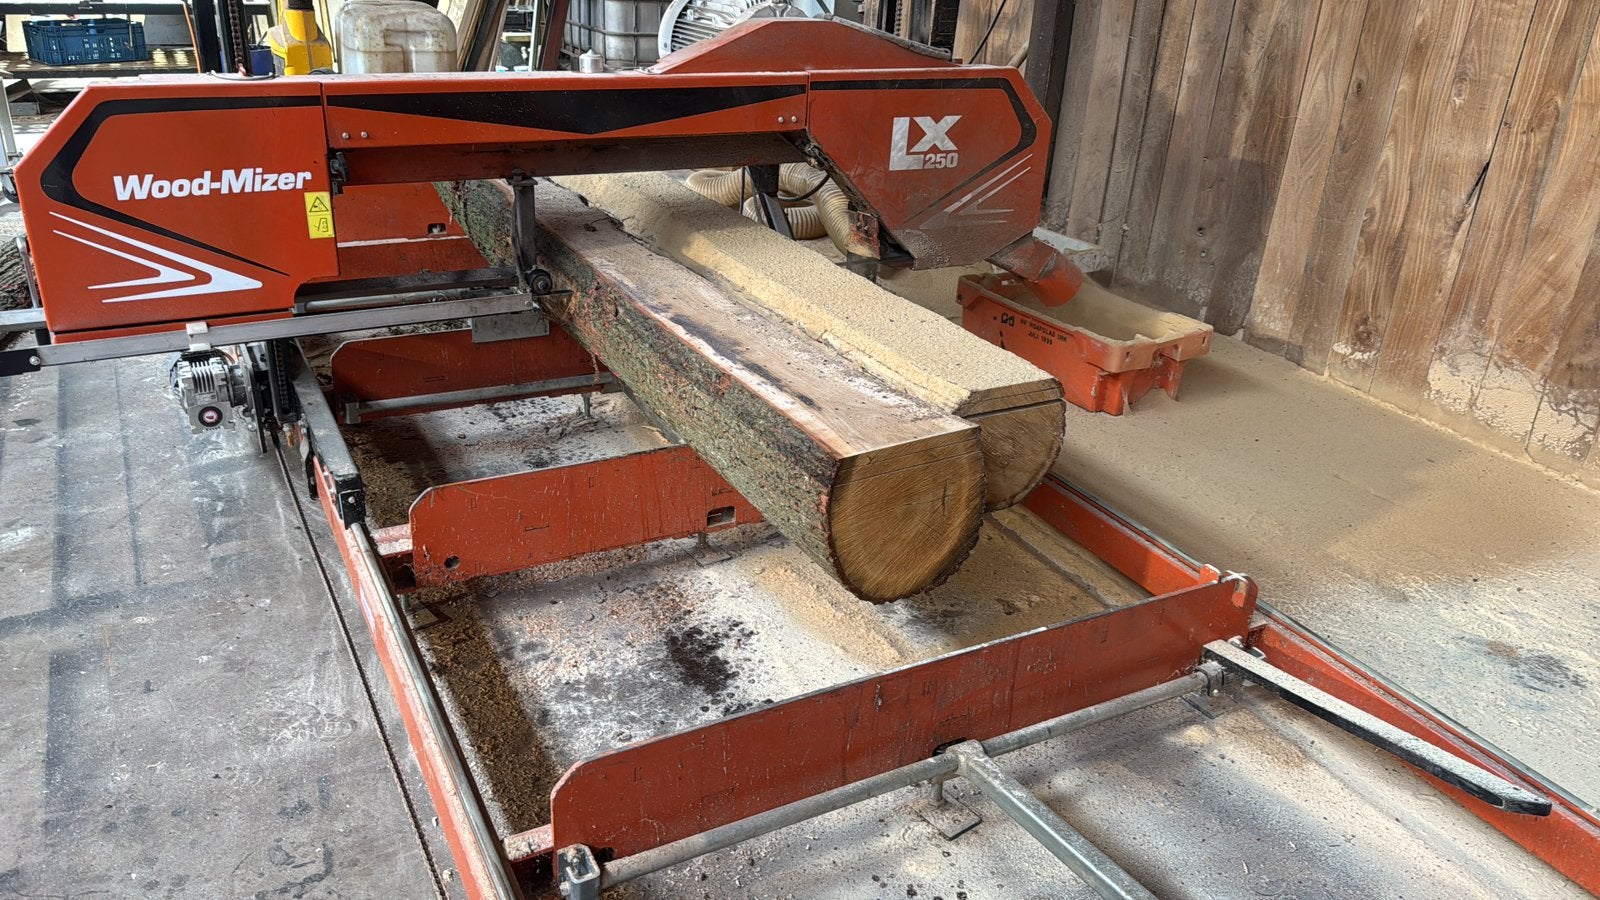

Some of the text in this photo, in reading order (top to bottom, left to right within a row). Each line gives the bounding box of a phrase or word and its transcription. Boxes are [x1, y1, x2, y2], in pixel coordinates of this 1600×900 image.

[889, 115, 962, 171] LX
[924, 152, 959, 169] 250
[113, 168, 312, 201] Wood-Mizer
[1028, 331, 1039, 339] JULI
